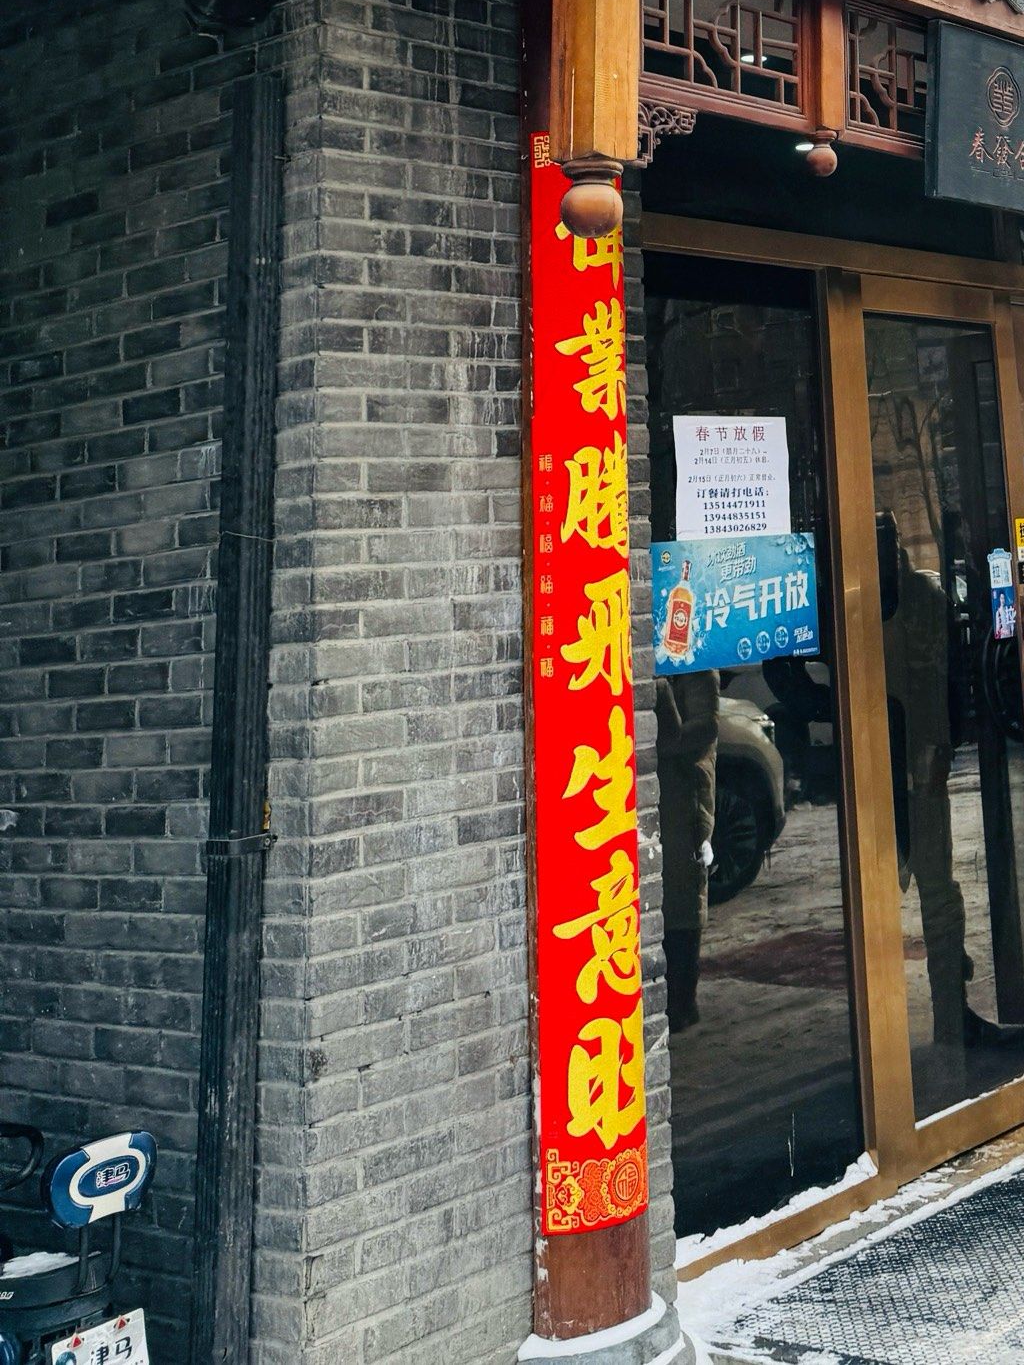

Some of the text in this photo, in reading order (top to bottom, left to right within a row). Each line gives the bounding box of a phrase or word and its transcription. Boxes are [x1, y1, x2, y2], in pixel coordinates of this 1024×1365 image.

[695, 425, 766, 442] 春节放假
[703, 499, 766, 510] 13514471911
[703, 511, 766, 522] 13944835151
[704, 523, 767, 534] 13843026829
[720, 554, 758, 584] 更带劲
[704, 569, 811, 631] 冷气开放
[95, 1161, 131, 1189] 津马
